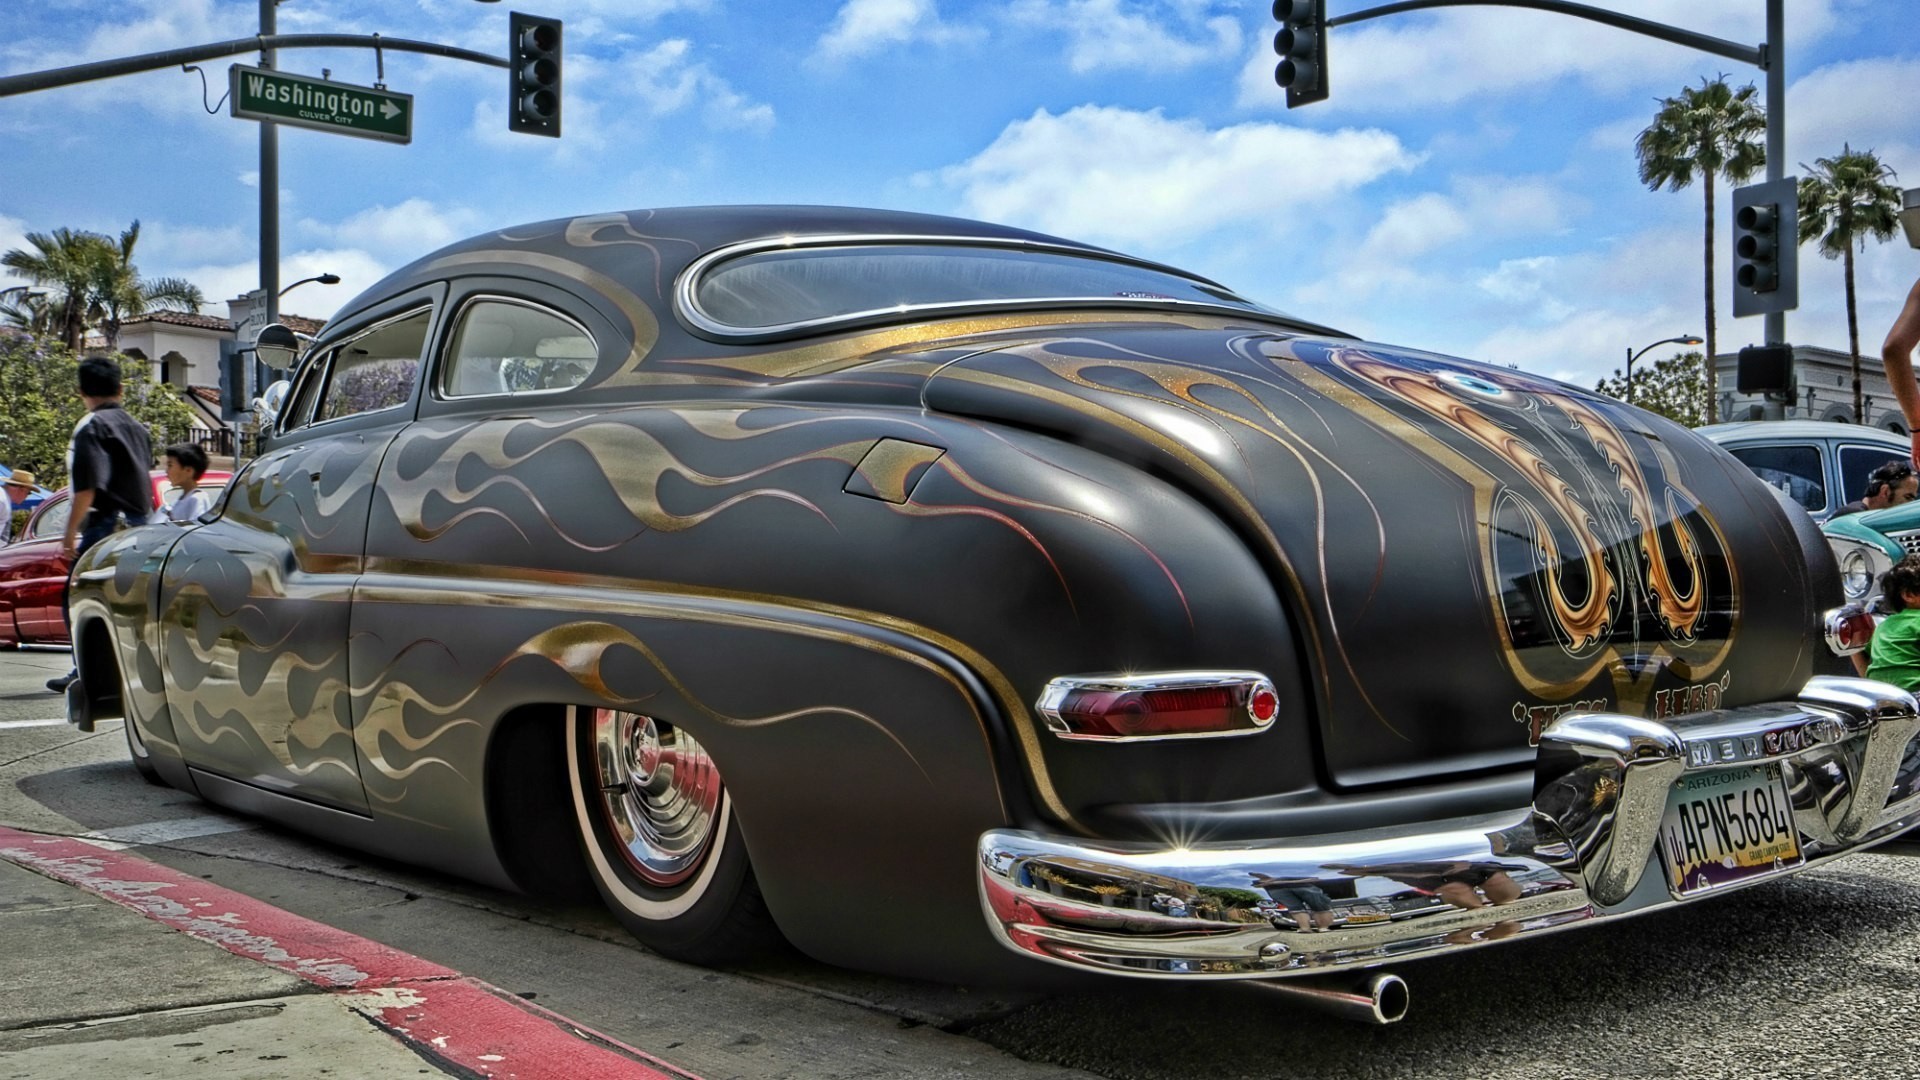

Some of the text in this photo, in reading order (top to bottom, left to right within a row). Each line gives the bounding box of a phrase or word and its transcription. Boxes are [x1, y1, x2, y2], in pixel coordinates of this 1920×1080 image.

[248, 74, 375, 118] Washington
[299, 110, 353, 125] CULVER CITY
[1687, 769, 1752, 791] ARIZONA
[1678, 785, 1789, 864] APN5684
[1749, 842, 1790, 860] GRAND CANYON STATE
